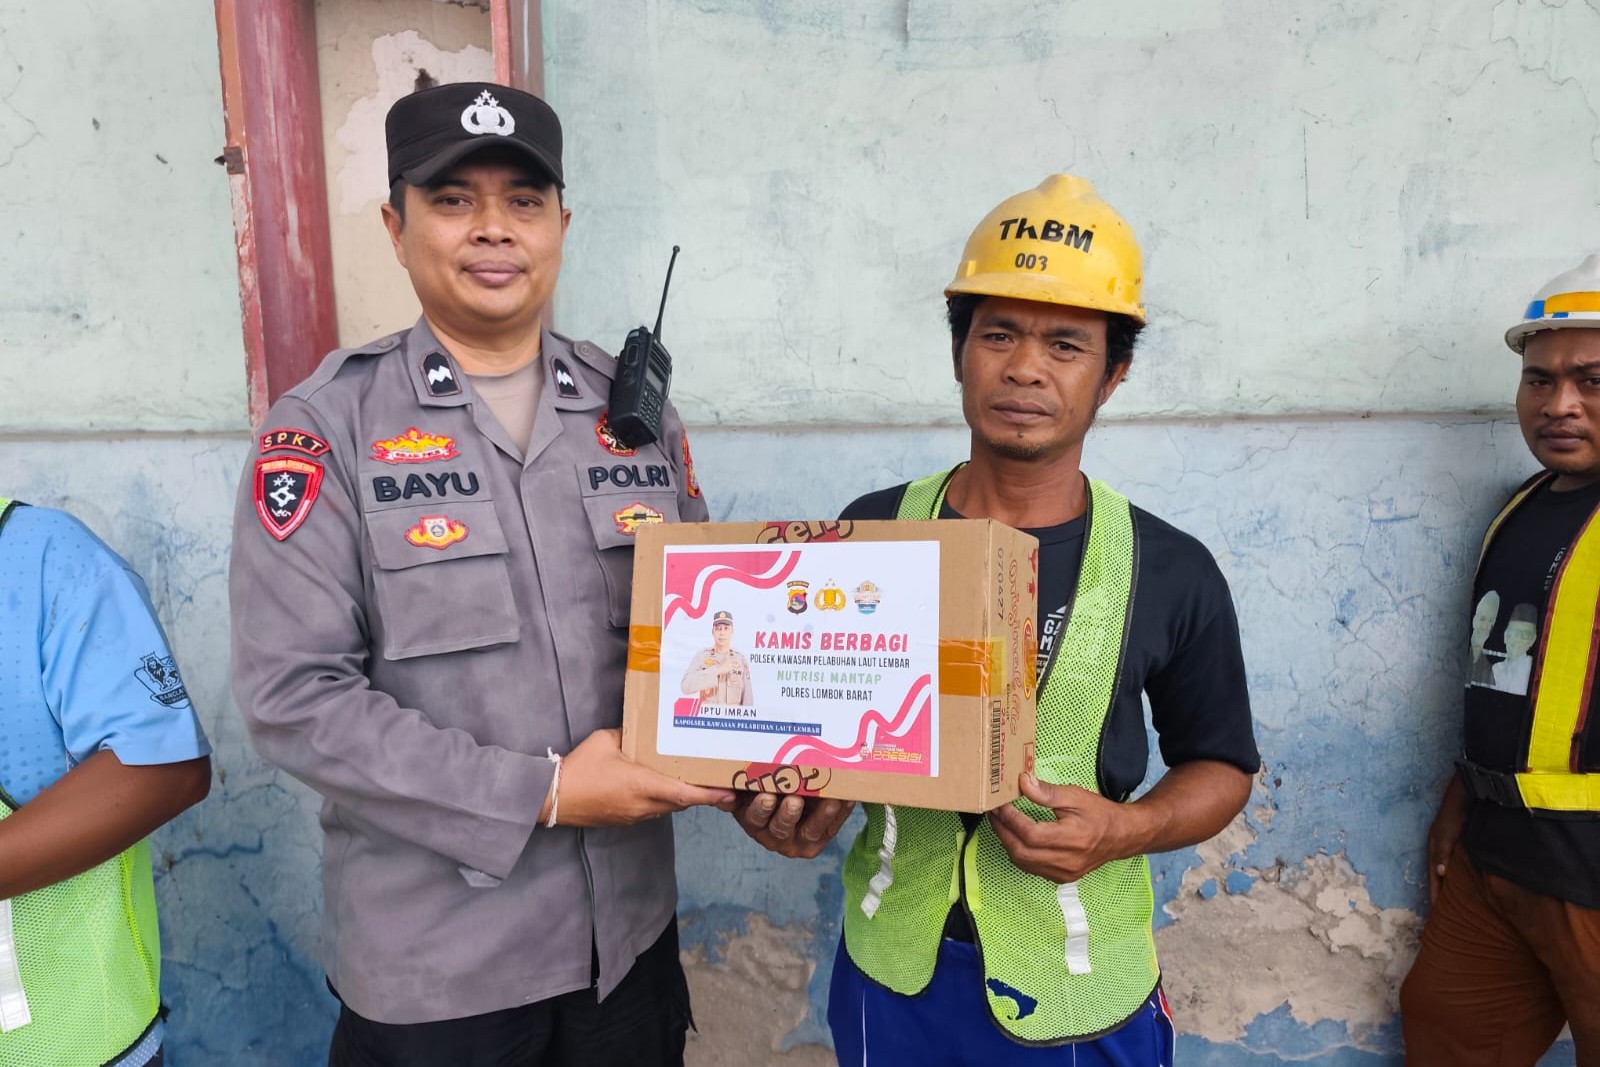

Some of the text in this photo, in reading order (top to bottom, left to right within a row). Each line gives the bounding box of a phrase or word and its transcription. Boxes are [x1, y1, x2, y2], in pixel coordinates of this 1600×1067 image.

[1015, 253, 1048, 271] 003
[264, 432, 323, 451] SPKT
[588, 464, 670, 490] POLRI
[372, 472, 480, 502] BAYU
[755, 631, 909, 652] KAMIS BERBAGI
[750, 654, 910, 669] POLSEK KAWASAN PELABUHAN LAUT LEMBAR
[777, 670, 882, 685] NUTRISI MANTAP
[781, 687, 873, 701] POLRES LOMBOK BARAT
[700, 707, 757, 718] IPTU IMRAN
[675, 718, 705, 727] KAPOLSEK
[737, 722, 775, 731] PELABUHAN
[775, 724, 792, 732] LAUT
[793, 726, 821, 735] LEMBAR
